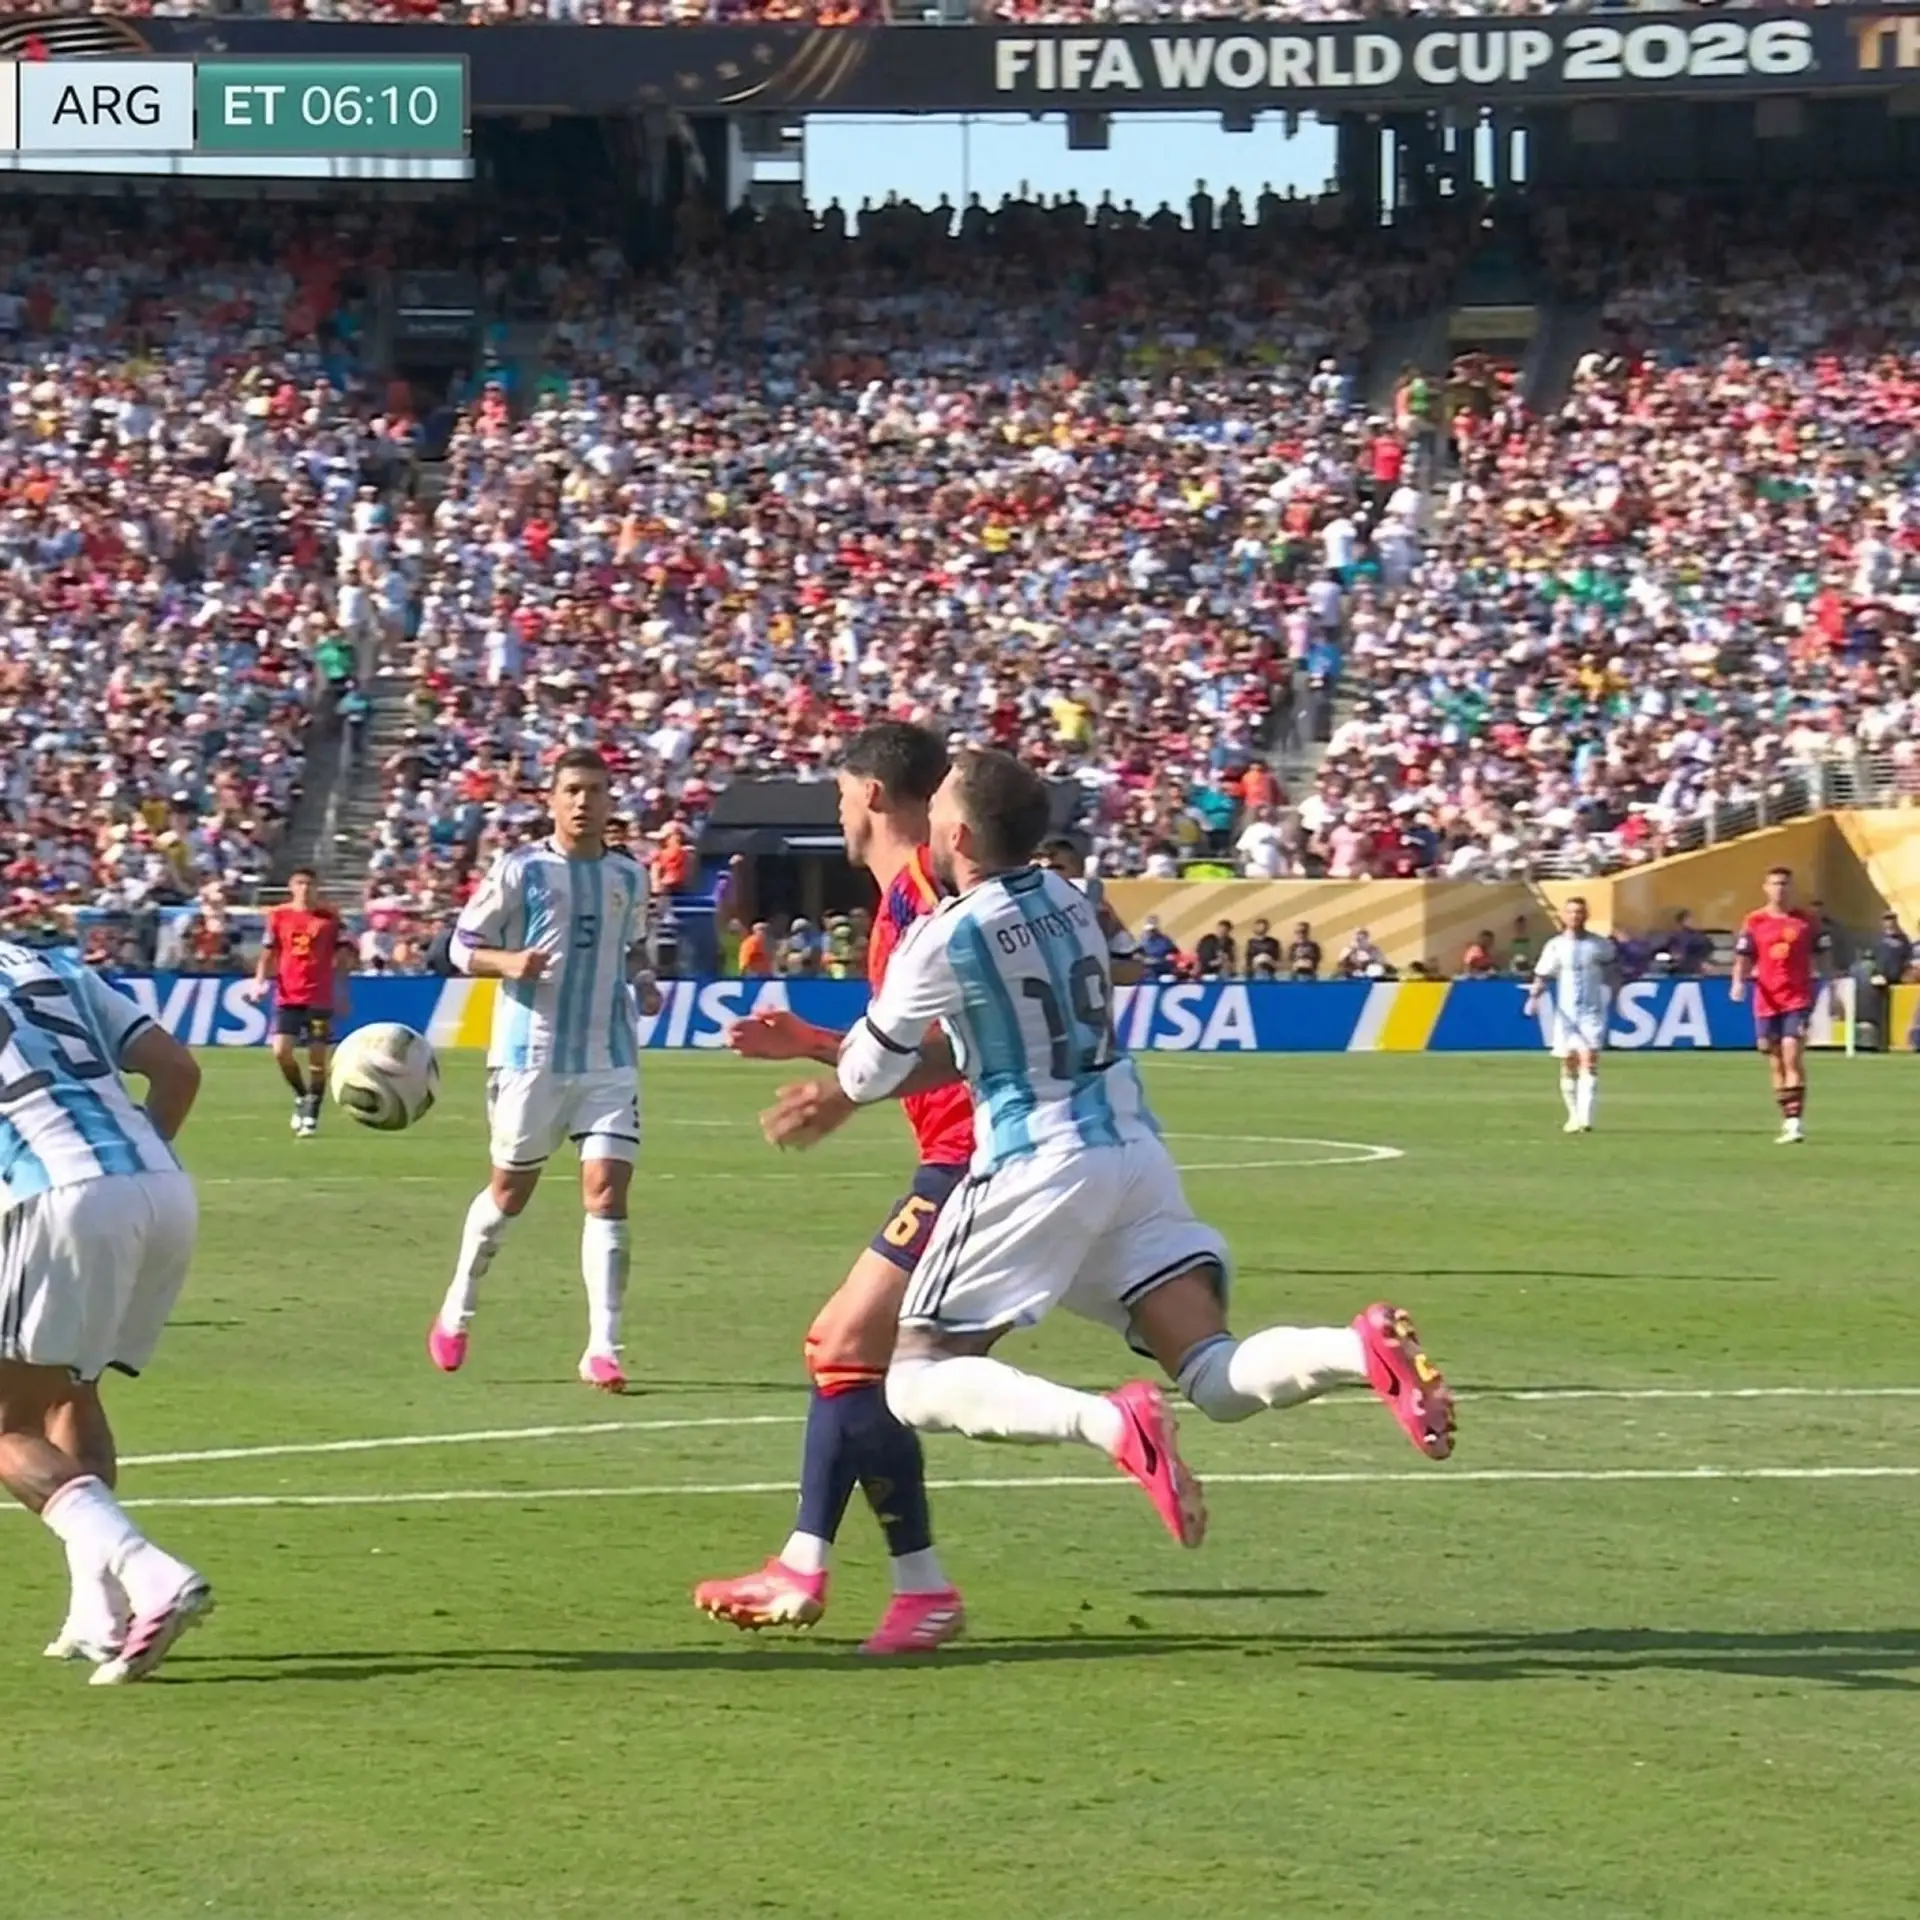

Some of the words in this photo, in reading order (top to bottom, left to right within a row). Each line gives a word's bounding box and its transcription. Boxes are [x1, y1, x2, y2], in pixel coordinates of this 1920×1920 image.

[995, 38, 1142, 90] FIFA
[1150, 35, 1401, 89] WORLD
[1413, 29, 1553, 84] CUP
[1562, 20, 1812, 80] 2026
[574, 915, 597, 949] 5
[115, 977, 276, 1046] VIS
[1113, 984, 1258, 1050] ISA
[882, 1195, 938, 1247] 6
